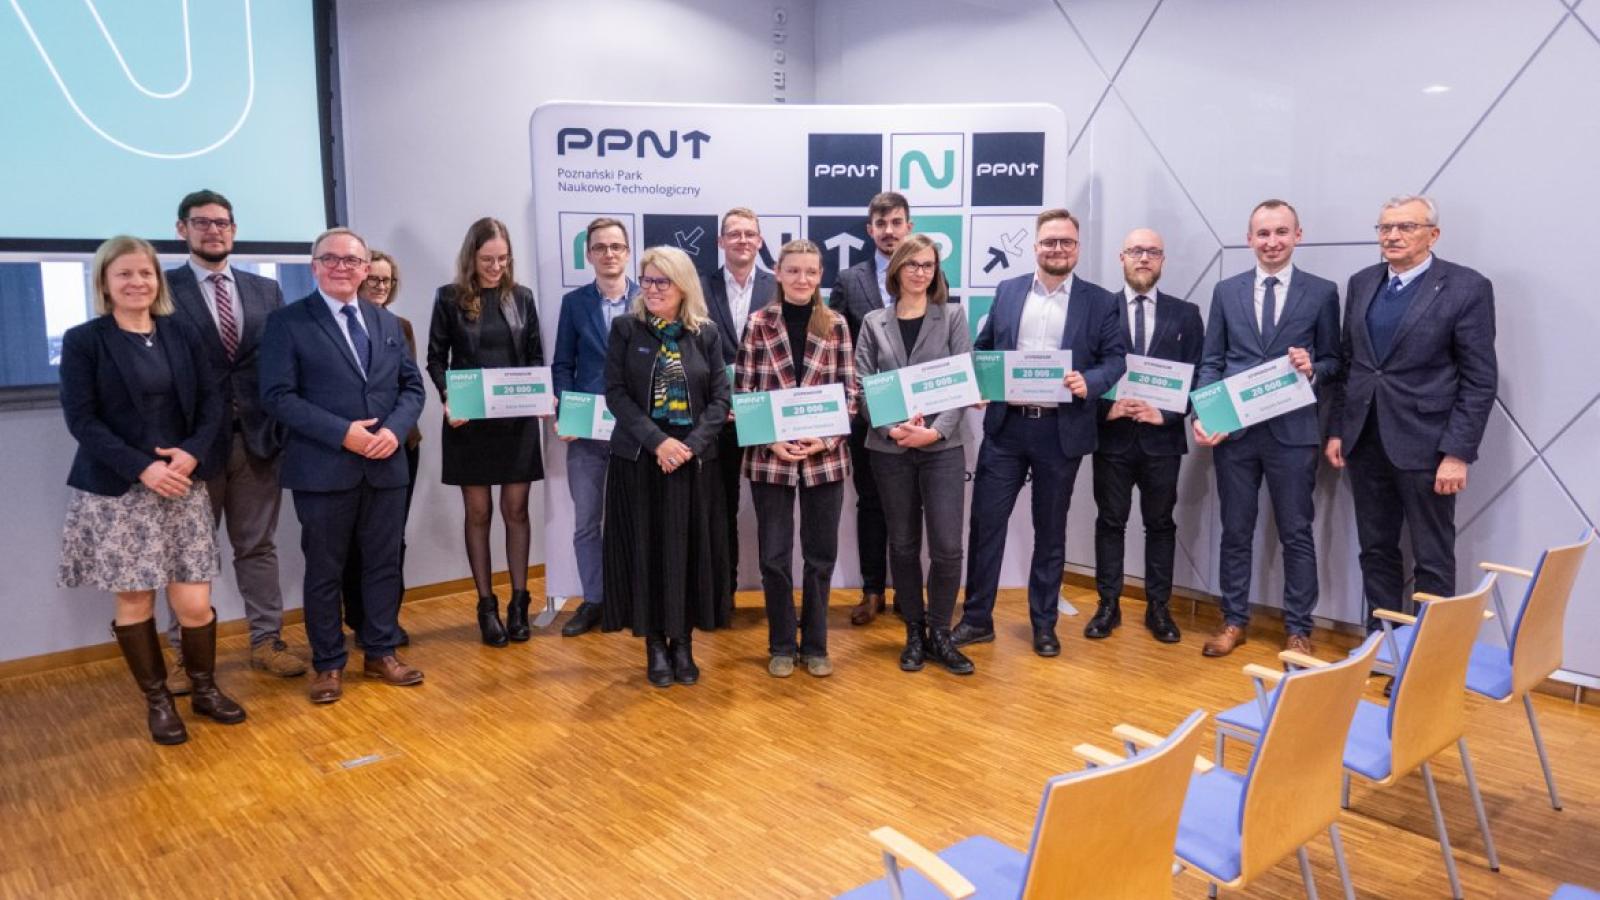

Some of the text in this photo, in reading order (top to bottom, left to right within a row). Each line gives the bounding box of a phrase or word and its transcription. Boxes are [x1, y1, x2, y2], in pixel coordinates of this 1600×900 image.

[557, 127, 712, 159] PPNT
[557, 168, 643, 180] Poznański Park
[814, 164, 879, 177] PPNT
[976, 162, 1039, 176] PPNT
[558, 182, 701, 197] Naukowo-Technologiczny
[503, 386, 515, 394] 20
[1252, 387, 1264, 397] 20
[793, 406, 805, 415] 20
